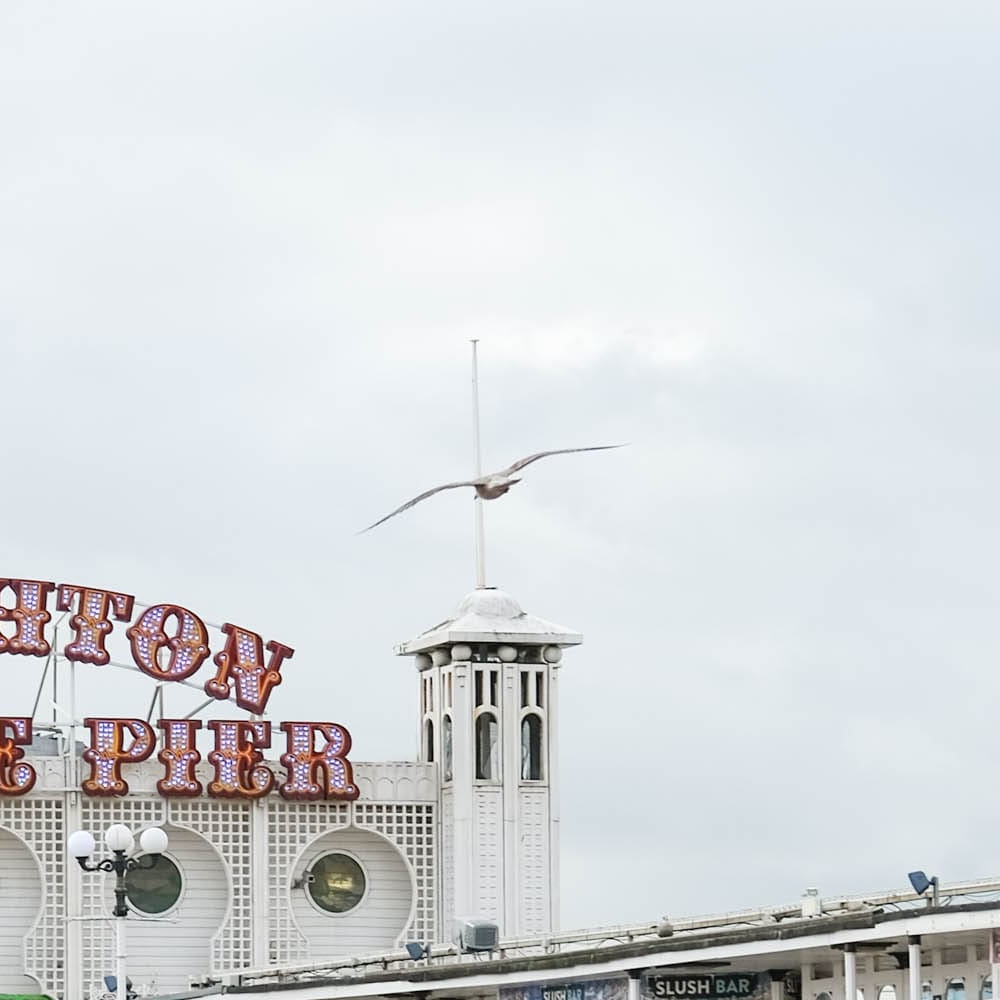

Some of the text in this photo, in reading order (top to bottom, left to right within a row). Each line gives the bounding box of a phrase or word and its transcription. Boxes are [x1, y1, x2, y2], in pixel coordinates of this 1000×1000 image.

[82, 718, 361, 801] PIER
[655, 978, 750, 995] SLUSH BAR
